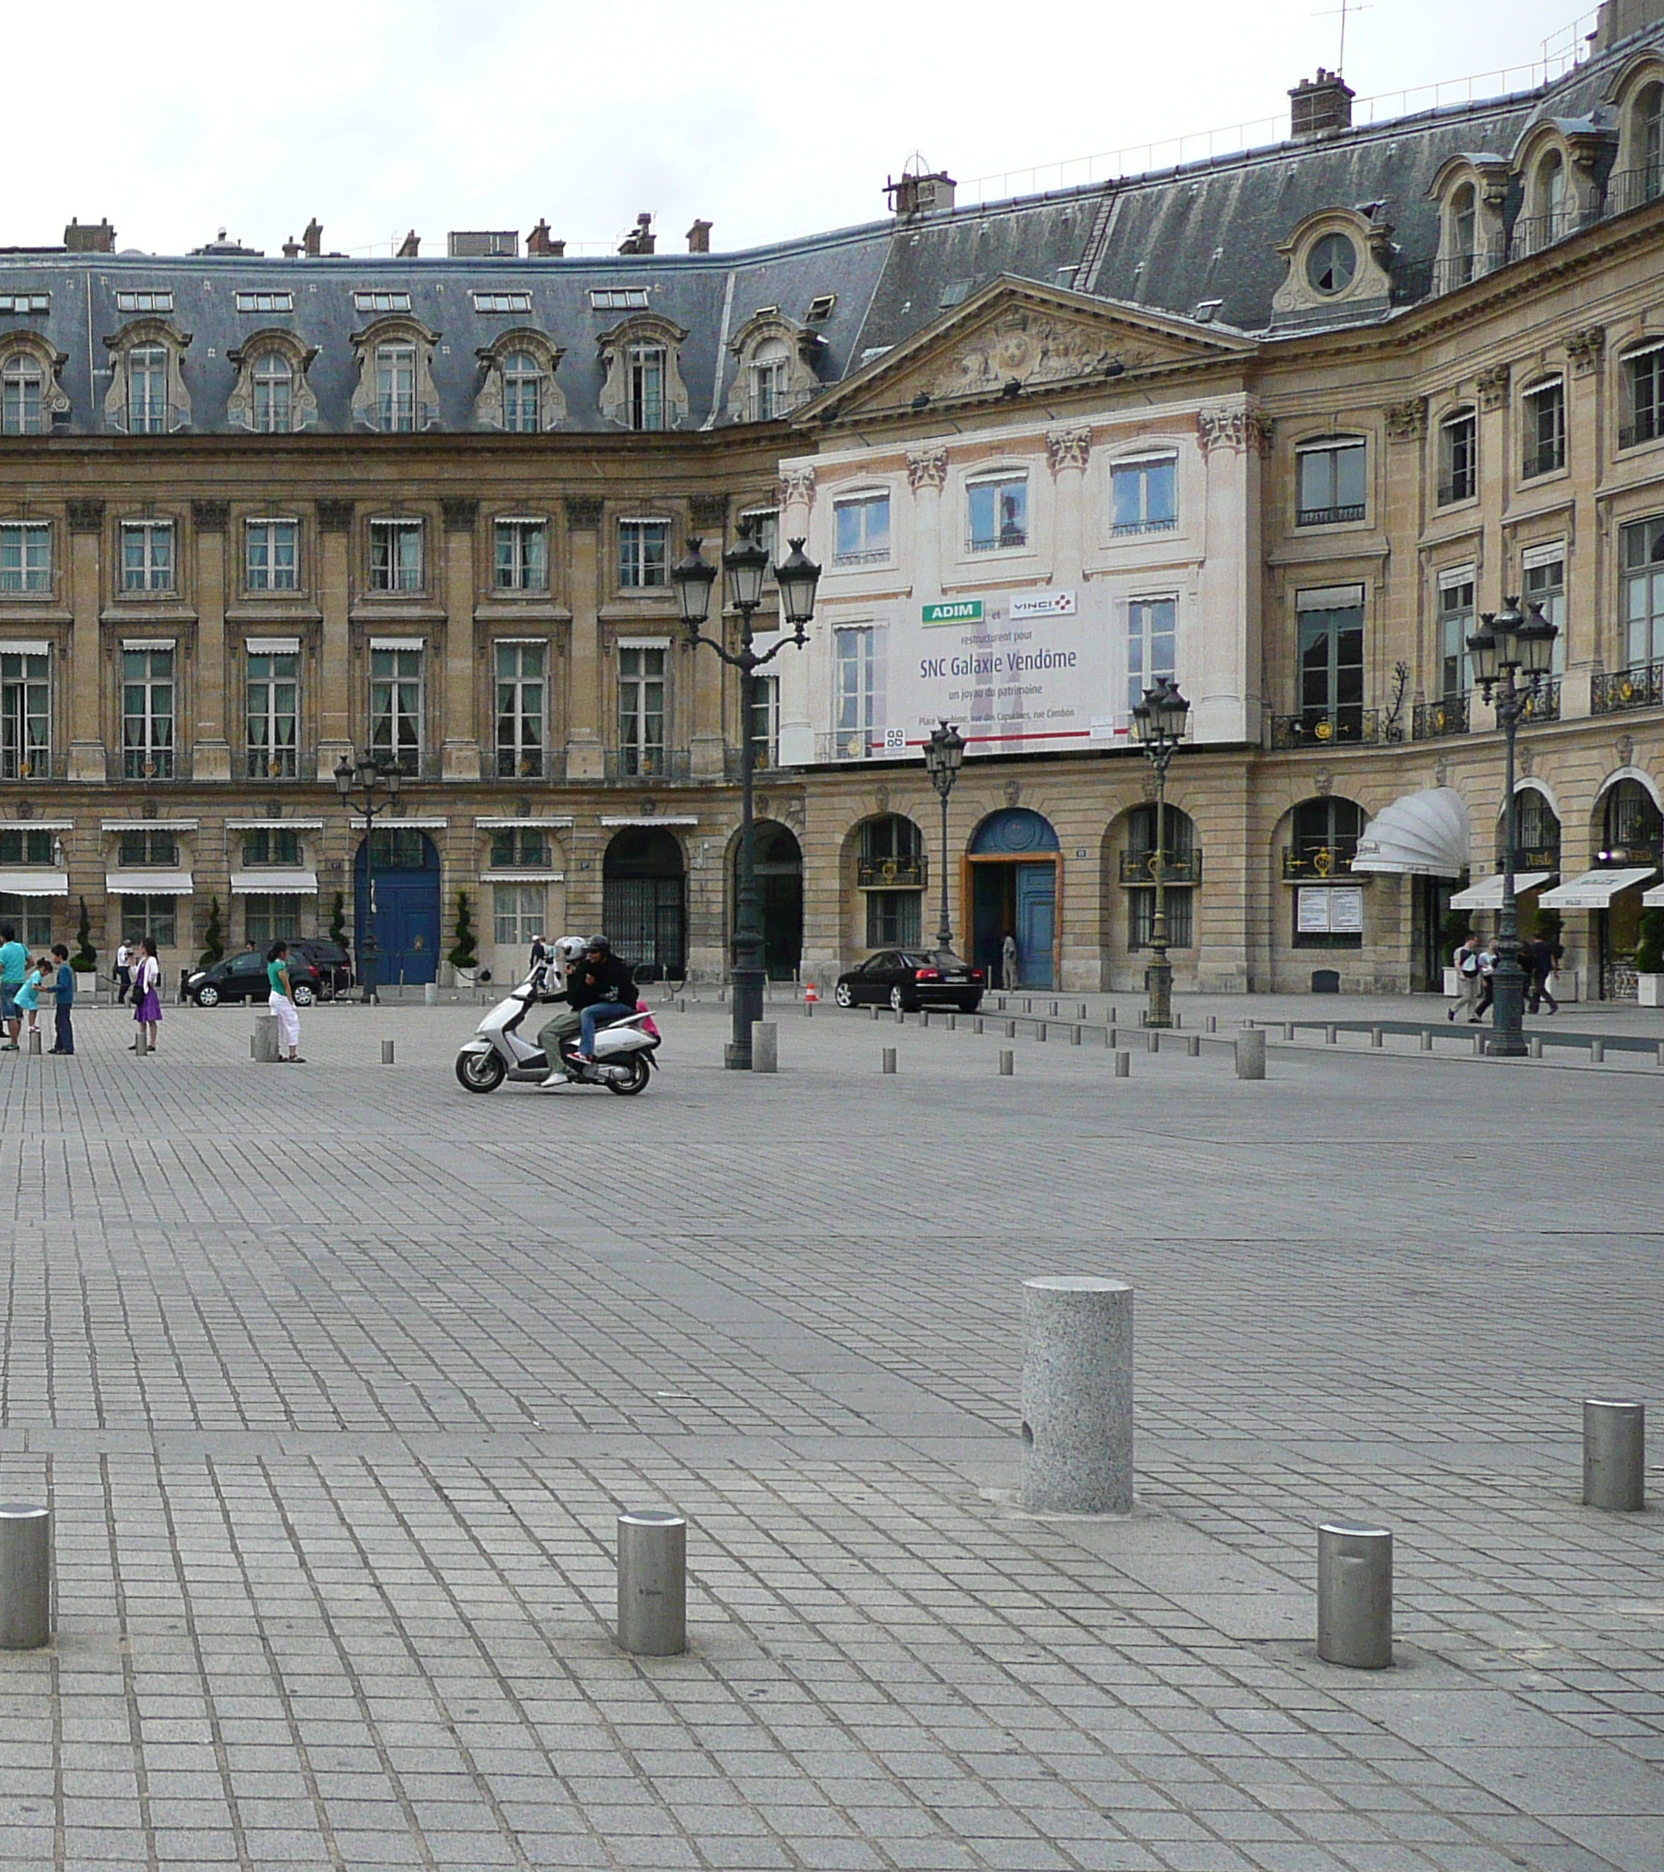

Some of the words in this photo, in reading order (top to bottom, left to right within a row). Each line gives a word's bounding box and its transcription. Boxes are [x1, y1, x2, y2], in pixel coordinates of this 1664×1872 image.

[932, 604, 973, 619] ADIM
[1014, 600, 1052, 610] VINCI
[992, 610, 1001, 620] et
[961, 631, 1012, 646] restructurent
[1014, 630, 1033, 643] pour
[920, 658, 946, 678] SNC
[951, 653, 1003, 676] Galaxie
[1007, 648, 1077, 672] Vendôme
[949, 691, 960, 700] un
[961, 689, 984, 702] joyau
[986, 686, 996, 698] du
[997, 683, 1043, 702] patrimoine
